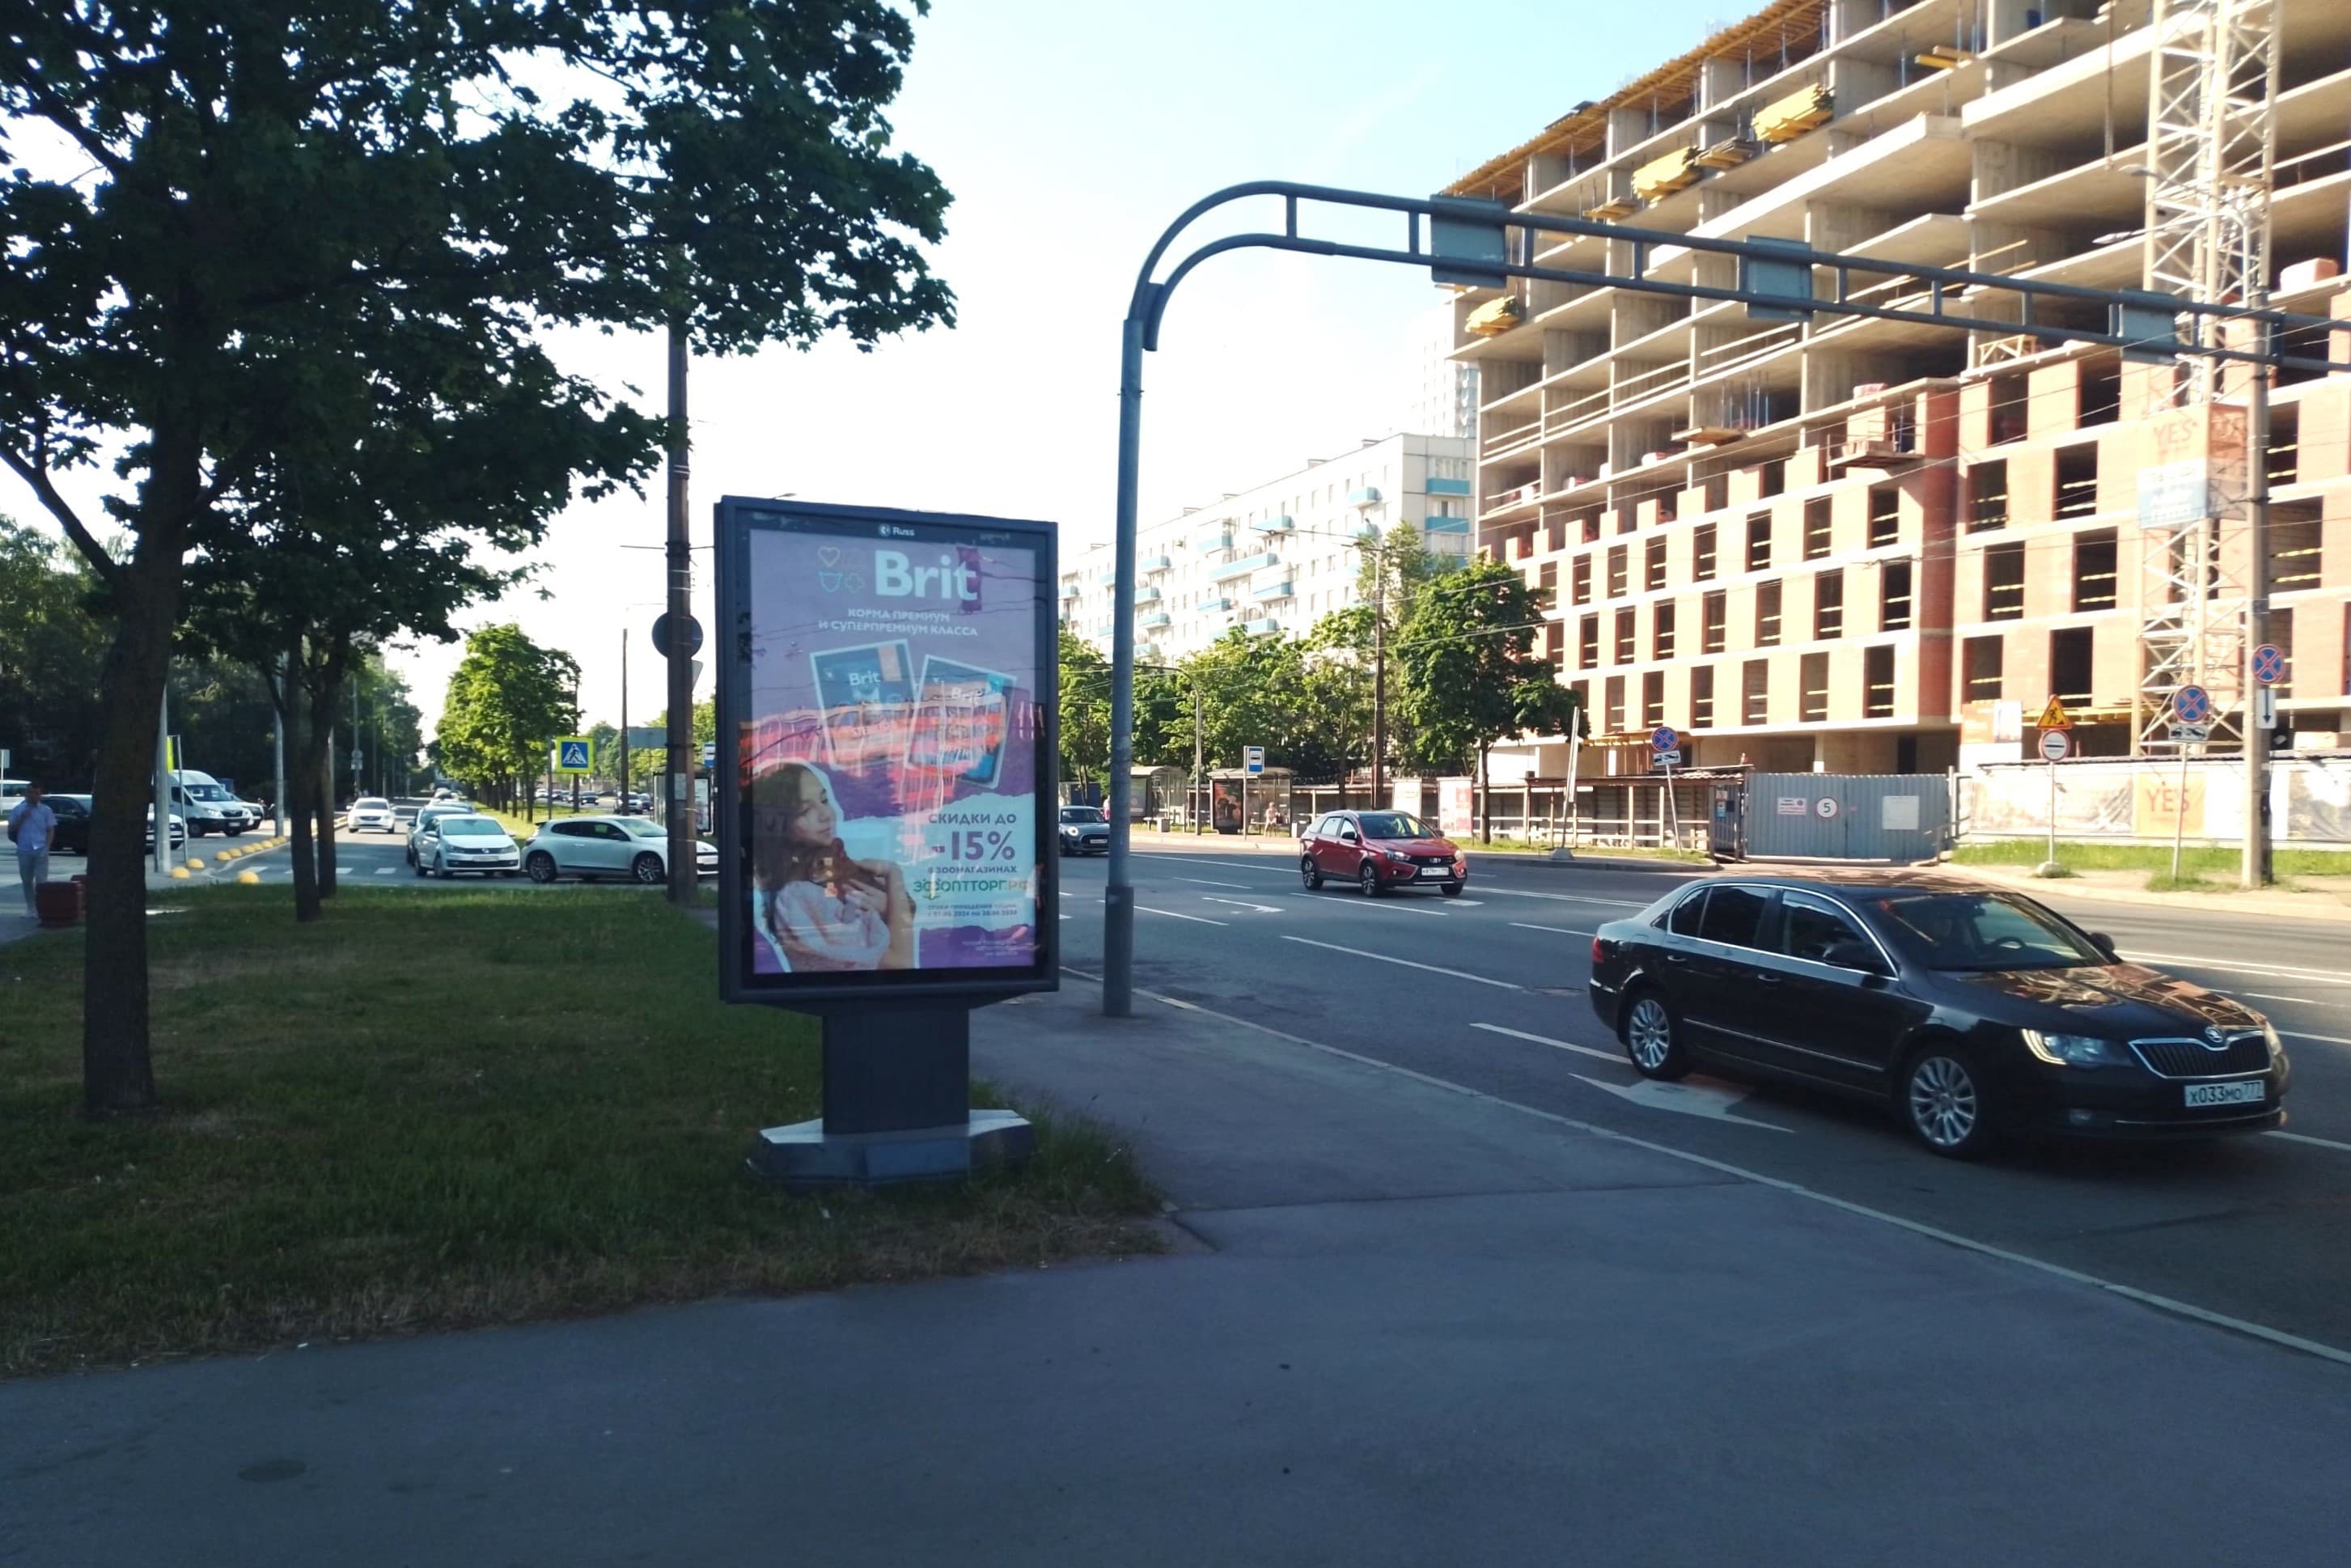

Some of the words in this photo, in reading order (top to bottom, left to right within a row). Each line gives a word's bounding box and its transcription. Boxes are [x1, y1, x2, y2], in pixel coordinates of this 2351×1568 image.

[892, 528, 915, 536] Russ
[875, 550, 978, 600] Brit
[848, 608, 890, 619] КОРМА
[892, 610, 950, 623] ПРЕМИУМ
[819, 621, 828, 629] И
[831, 621, 928, 634] СУПЕРПРЕМИУМ
[930, 625, 978, 636] КЛАССА
[849, 671, 880, 686] Brit
[1824, 803, 1831, 813] 5
[928, 813, 991, 825] СКИДКИ
[994, 814, 1017, 825] ДО
[931, 831, 1016, 861] -15%
[935, 865, 1017, 874] ЗООМАГАЗИНАХ
